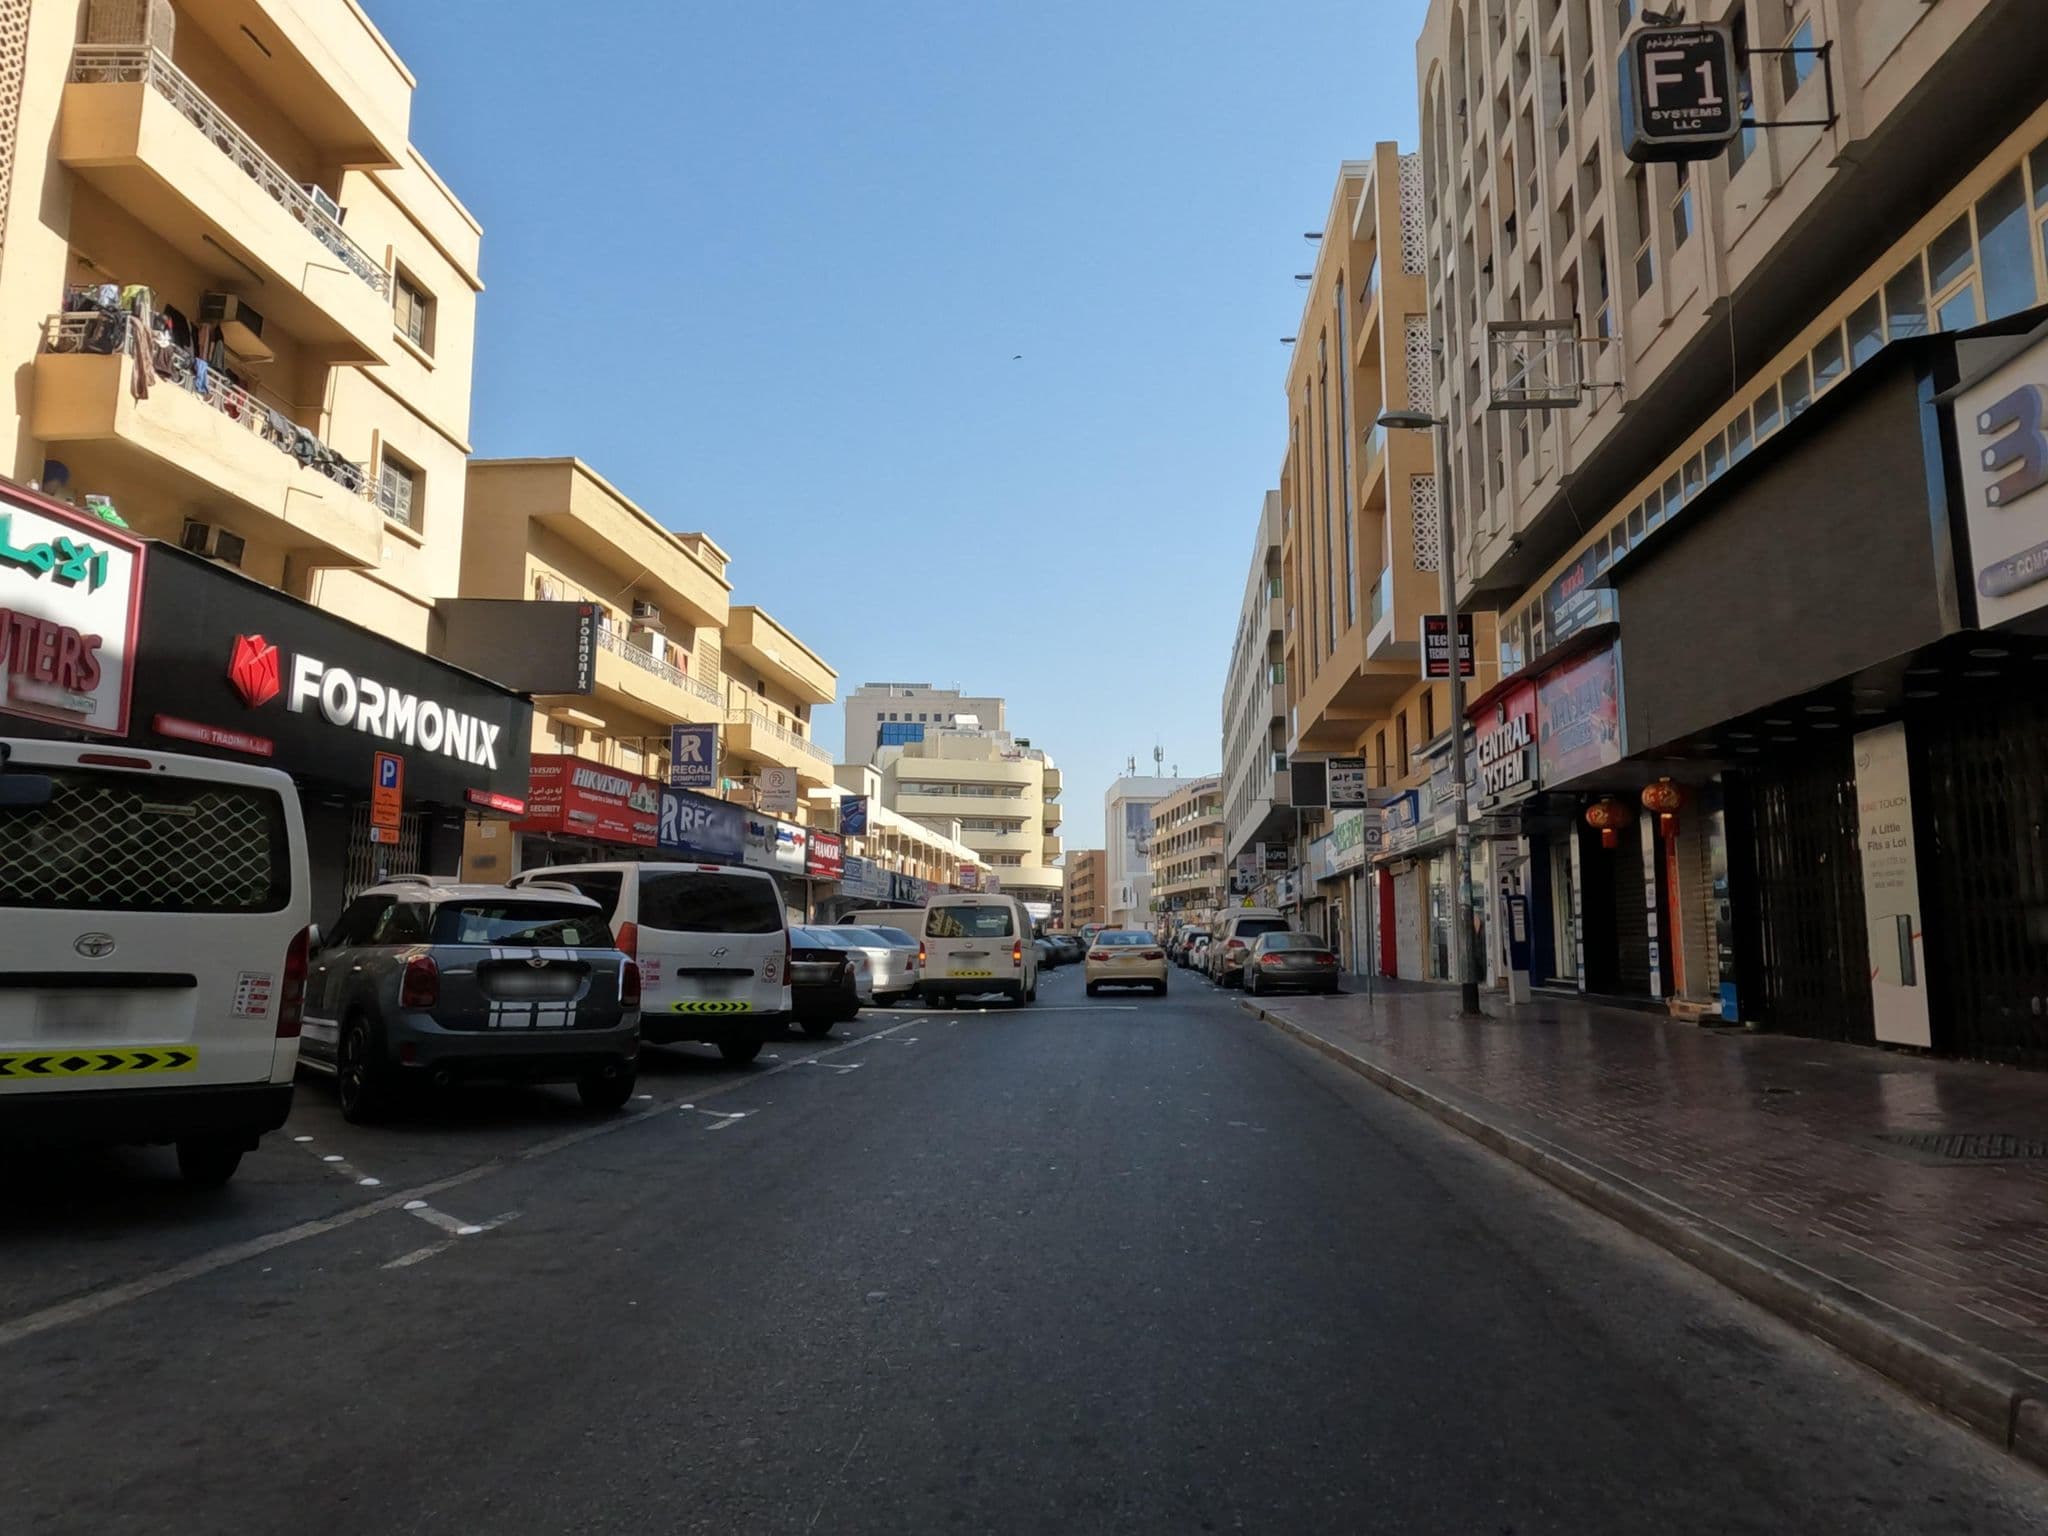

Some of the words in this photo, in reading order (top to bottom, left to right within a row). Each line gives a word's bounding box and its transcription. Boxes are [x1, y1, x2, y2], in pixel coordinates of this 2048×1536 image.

[1651, 107, 1722, 120] SYSTEMS
[1672, 120, 1702, 130] LLC
[577, 617, 591, 689] FORMONIX
[287, 653, 500, 770] FORMONIX
[1477, 713, 1531, 768] CENTRAL
[672, 764, 711, 776] REGAL
[1483, 750, 1525, 797] SYSTEM
[571, 767, 633, 798] HIKVISION
[672, 774, 711, 783] COMPUTER
[529, 804, 561, 813] SECURITY
[1871, 827, 1877, 836] A
[1879, 822, 1901, 835] Little
[1867, 840, 1883, 851] Fits
